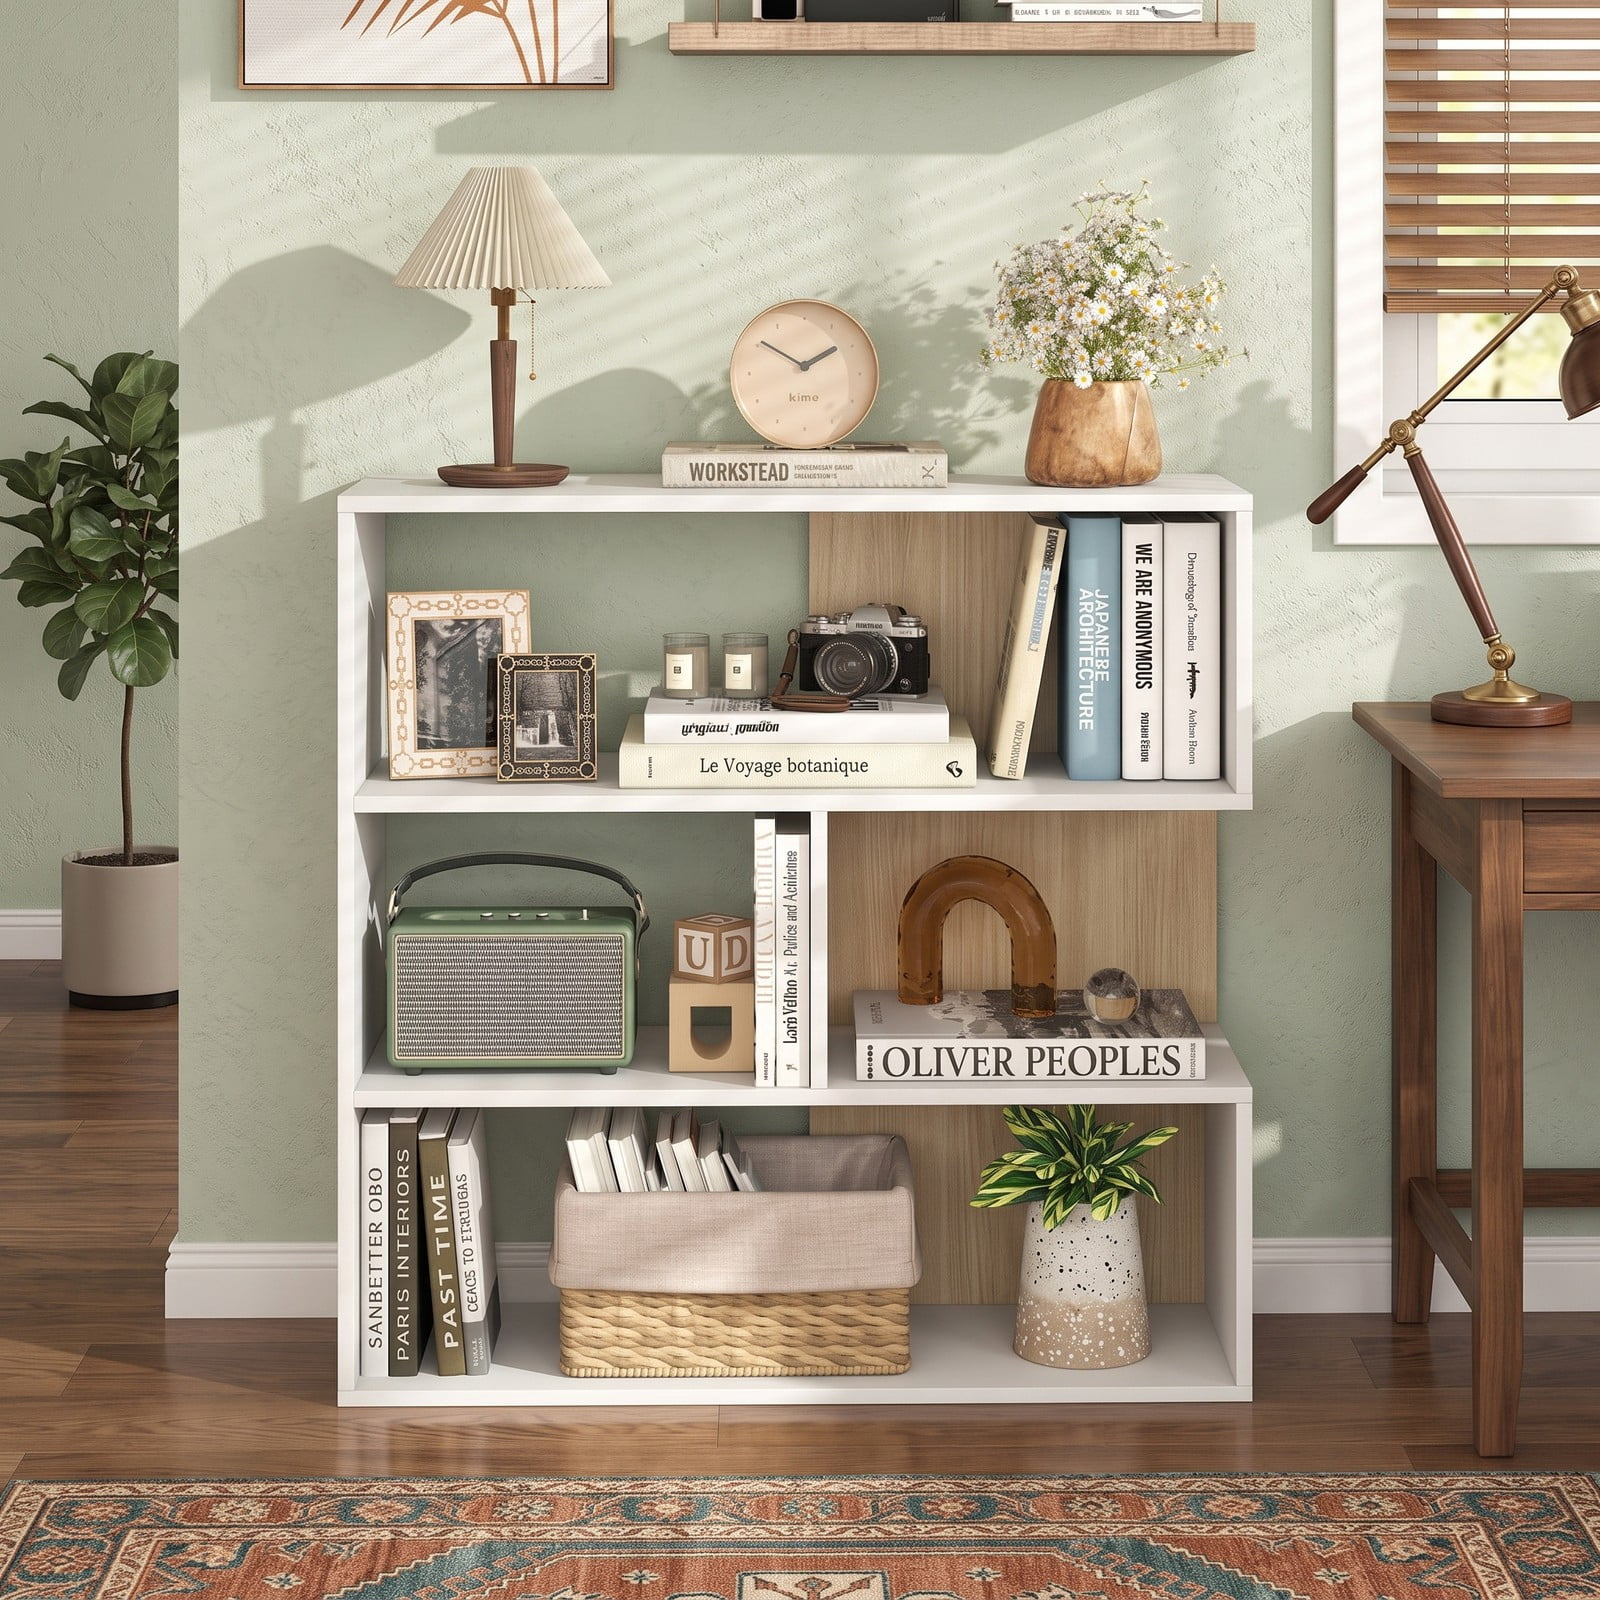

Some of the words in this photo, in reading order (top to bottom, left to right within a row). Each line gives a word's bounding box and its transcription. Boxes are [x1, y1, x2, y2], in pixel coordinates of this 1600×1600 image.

[788, 392, 820, 403] kime
[689, 462, 789, 482] WORKSTEAD
[1135, 543, 1153, 565] WE
[1135, 569, 1153, 597] ARE
[1135, 600, 1153, 690] ANONYMOUS
[700, 757, 719, 774] Le
[723, 757, 782, 778] Voyage
[787, 757, 869, 778] botanique
[683, 934, 710, 971] U
[724, 934, 748, 971] D
[882, 1046, 1015, 1078] OLIVER
[1025, 1045, 1181, 1077] PEOPLES
[368, 1167, 383, 1213] OBO
[397, 1148, 410, 1278] INTERIORS
[430, 1174, 451, 1254] TIME
[462, 1247, 474, 1266] TO
[368, 1221, 383, 1349] SANBETTER
[397, 1288, 410, 1361] PARIS
[437, 1269, 459, 1348] PAST
